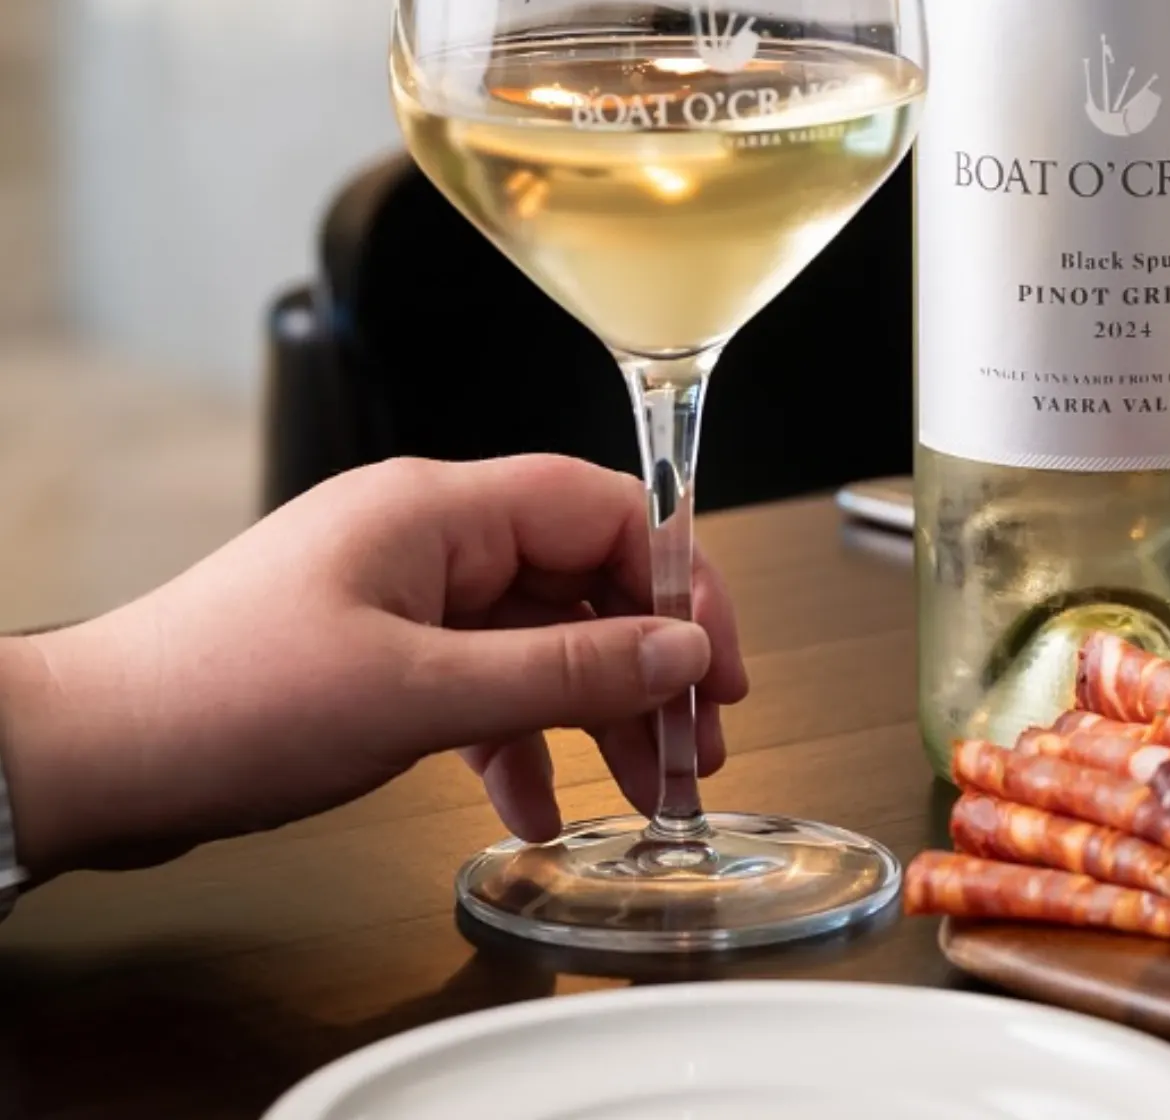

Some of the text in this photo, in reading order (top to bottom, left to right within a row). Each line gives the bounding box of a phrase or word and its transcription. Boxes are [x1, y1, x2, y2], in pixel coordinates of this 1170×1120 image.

[572, 92, 676, 129] BOAT
[954, 150, 1058, 196] BOAT
[1061, 251, 1124, 271] Black
[1017, 283, 1111, 306] PINOT
[1093, 320, 1153, 339] 2024
[1034, 371, 1115, 386] VINEYARD
[1117, 372, 1164, 386] FROM
[1032, 394, 1112, 414] YARRA
